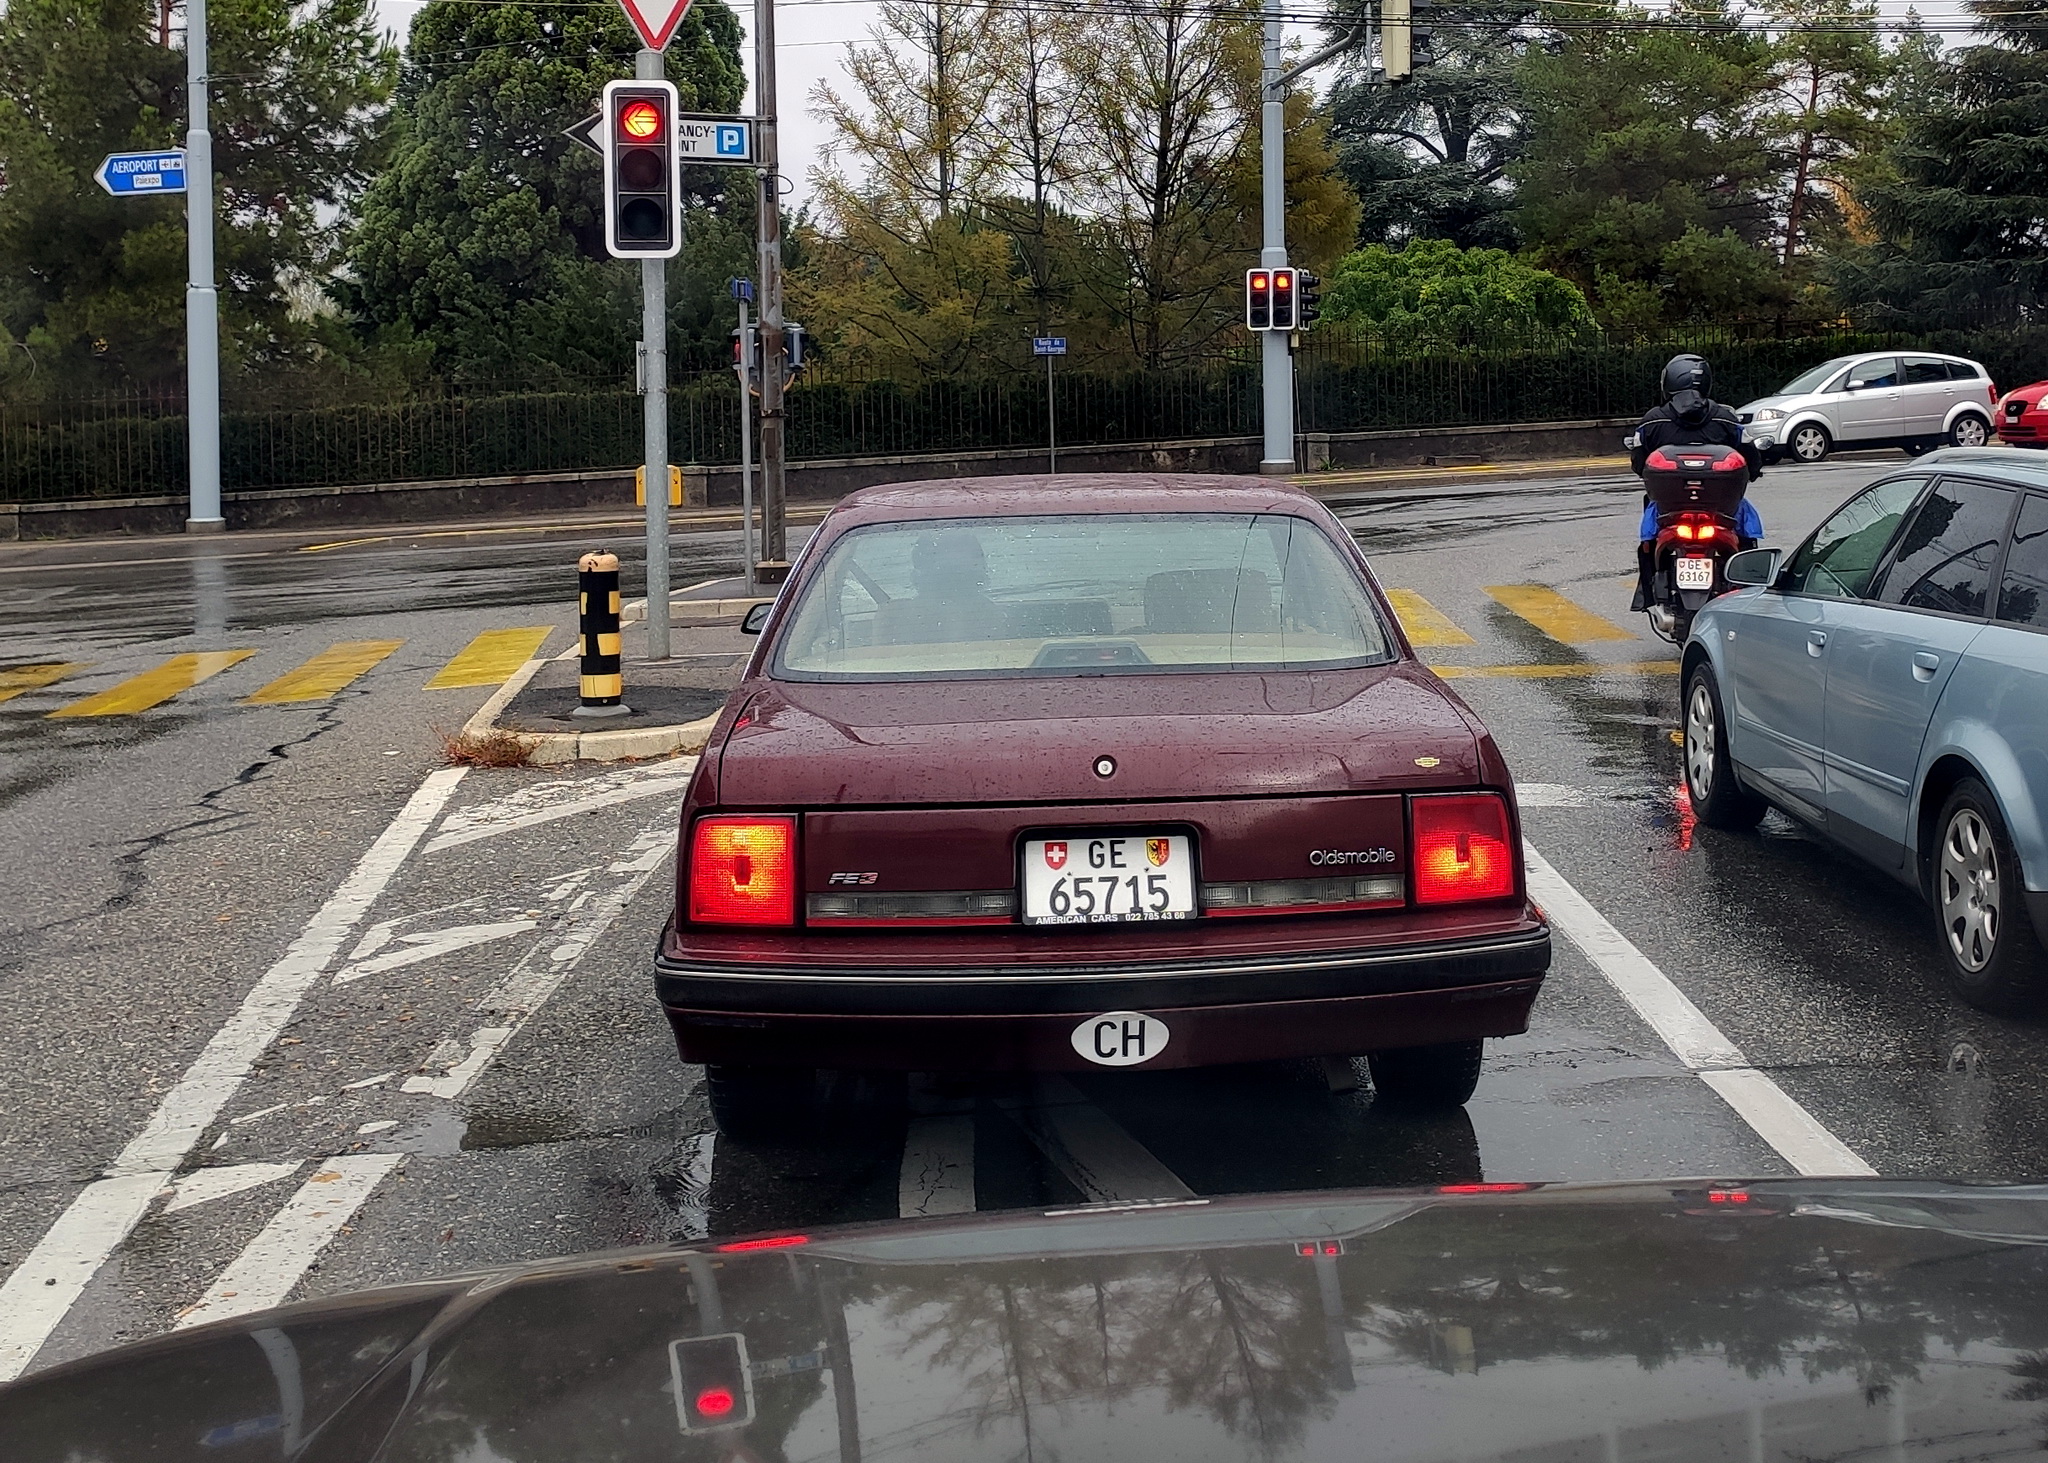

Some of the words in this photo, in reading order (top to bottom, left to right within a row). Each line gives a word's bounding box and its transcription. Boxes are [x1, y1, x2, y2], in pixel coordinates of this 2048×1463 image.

[678, 124, 716, 138] ANCY-
[678, 140, 698, 152] NT
[722, 129, 740, 152] P
[112, 159, 158, 173] AEROPORT
[1687, 560, 1702, 570] GE
[1679, 571, 1710, 582] 63167
[1088, 840, 1127, 869] GE
[1309, 847, 1396, 866] Oldsmobile
[828, 872, 879, 885] FE3
[1049, 874, 1170, 916] 65715
[1035, 914, 1087, 925] AMERICAN
[1091, 914, 1118, 923] CARS
[1125, 912, 1143, 921] 022
[1161, 911, 1172, 920] 43
[1094, 1020, 1145, 1058] CH
